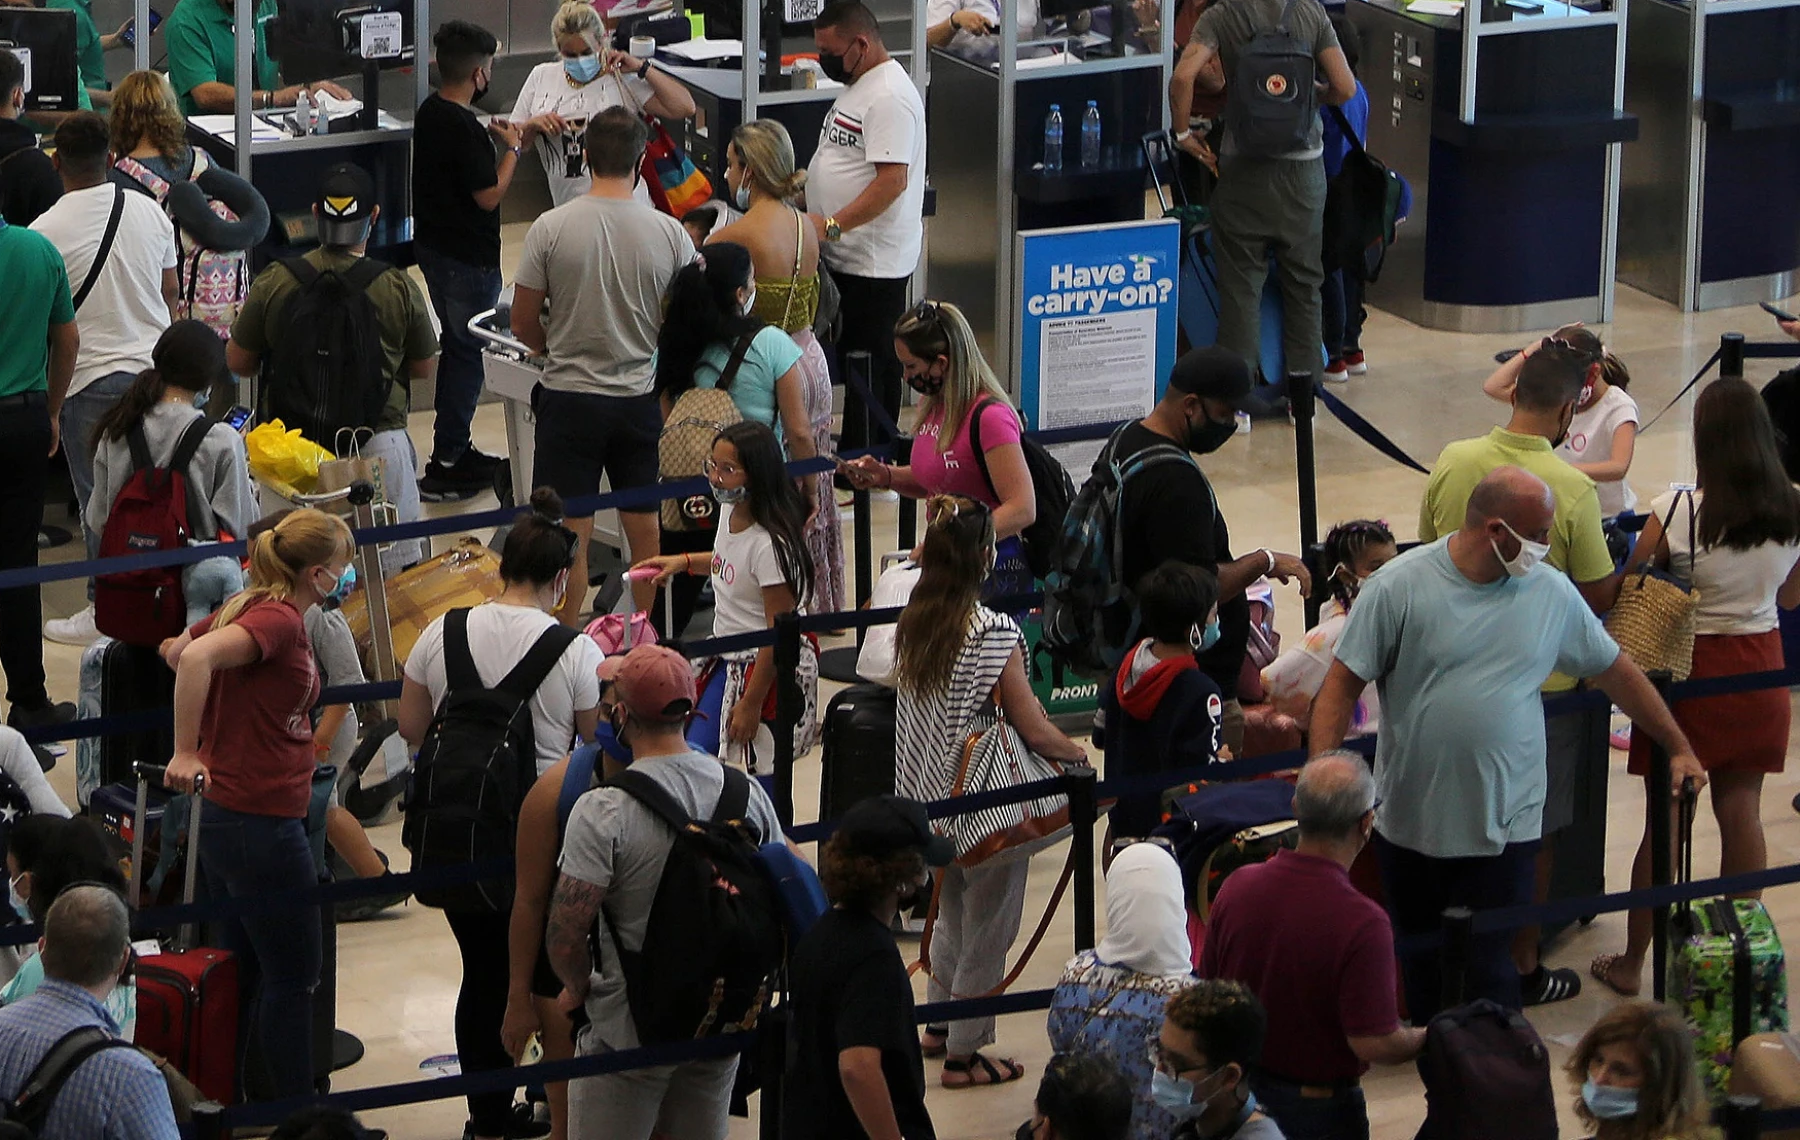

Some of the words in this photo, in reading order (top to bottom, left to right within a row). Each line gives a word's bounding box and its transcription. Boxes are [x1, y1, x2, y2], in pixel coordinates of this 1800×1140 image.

[1050, 261, 1126, 291] Have
[1132, 262, 1151, 282] a
[1028, 277, 1174, 316] carry-on?
